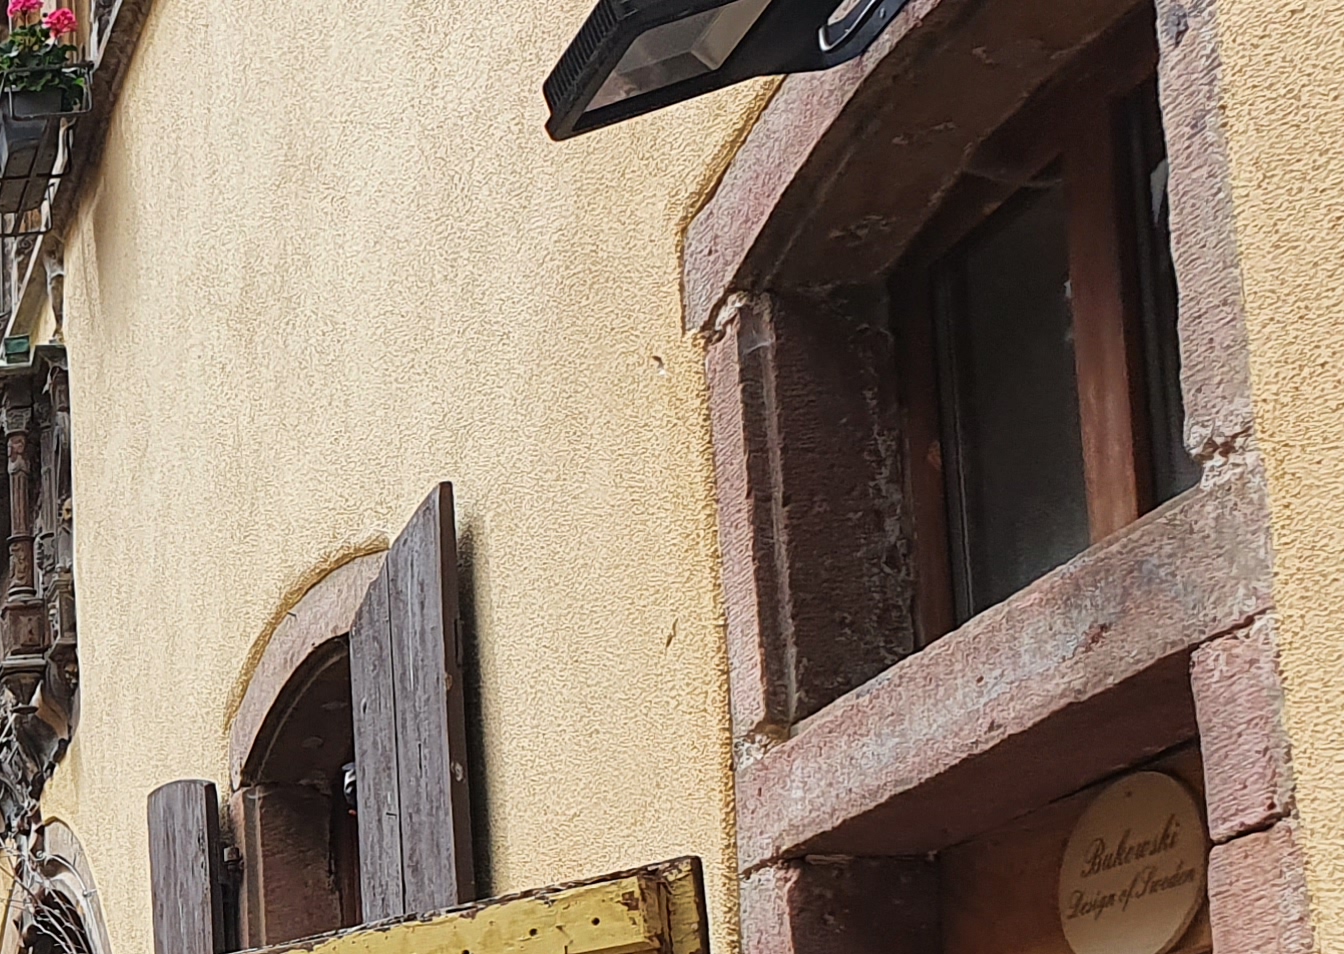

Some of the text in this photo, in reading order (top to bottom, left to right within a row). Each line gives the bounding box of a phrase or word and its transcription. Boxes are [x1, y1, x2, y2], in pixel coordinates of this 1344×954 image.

[1080, 813, 1181, 878] Bukowski
[1066, 860, 1197, 921] Design of Sweden
